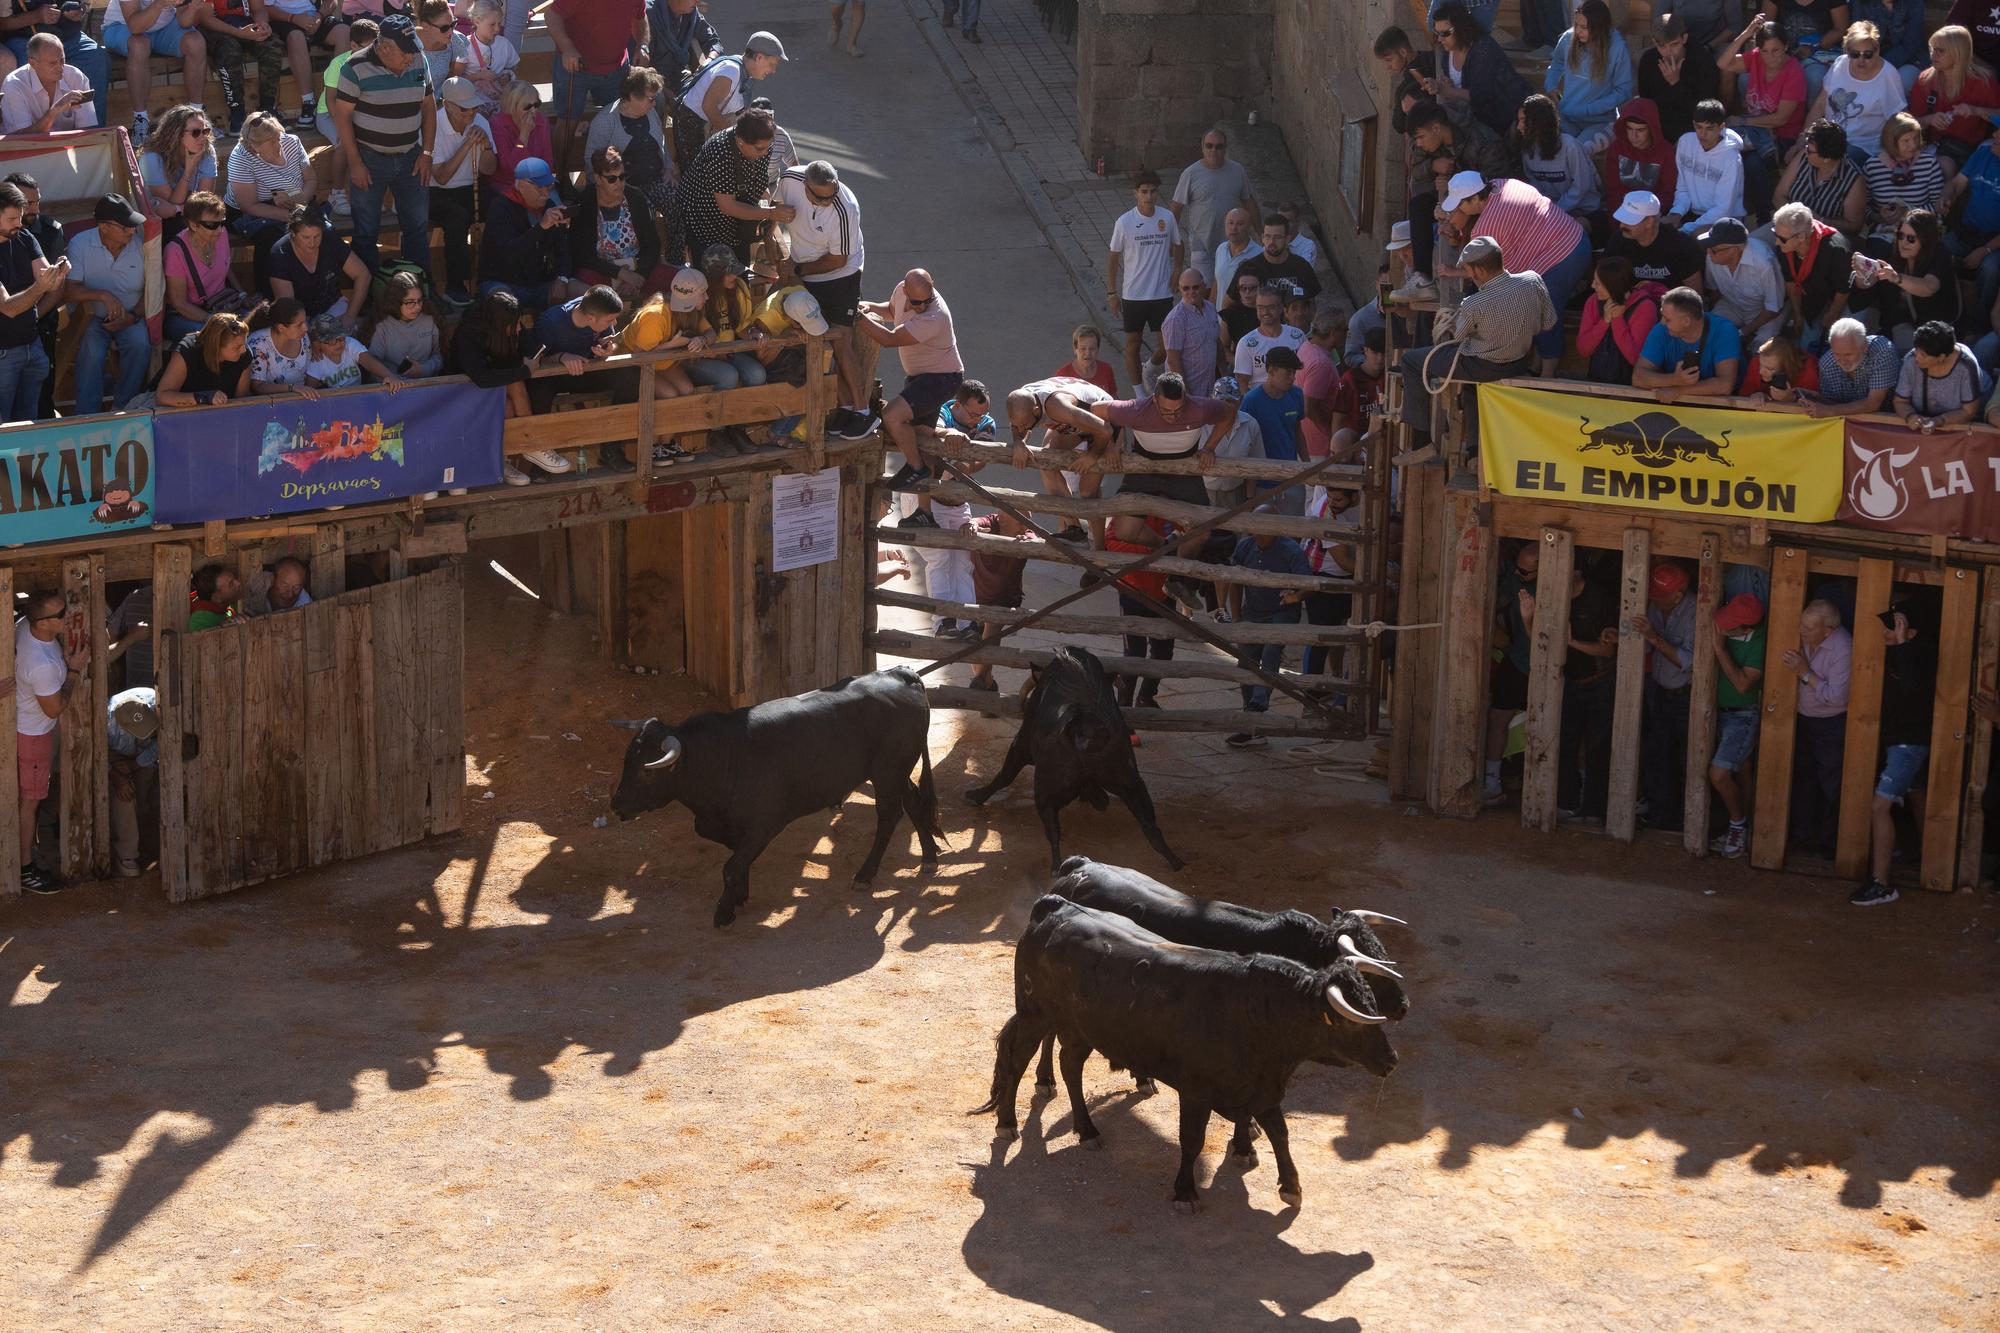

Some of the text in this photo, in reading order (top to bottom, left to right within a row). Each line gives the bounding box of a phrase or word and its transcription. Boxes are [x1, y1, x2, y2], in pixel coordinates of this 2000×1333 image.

[280, 477, 382, 500] Depravaos
[1515, 460, 1796, 513] EL EMPUJÓN
[1920, 460, 1974, 499] LA
